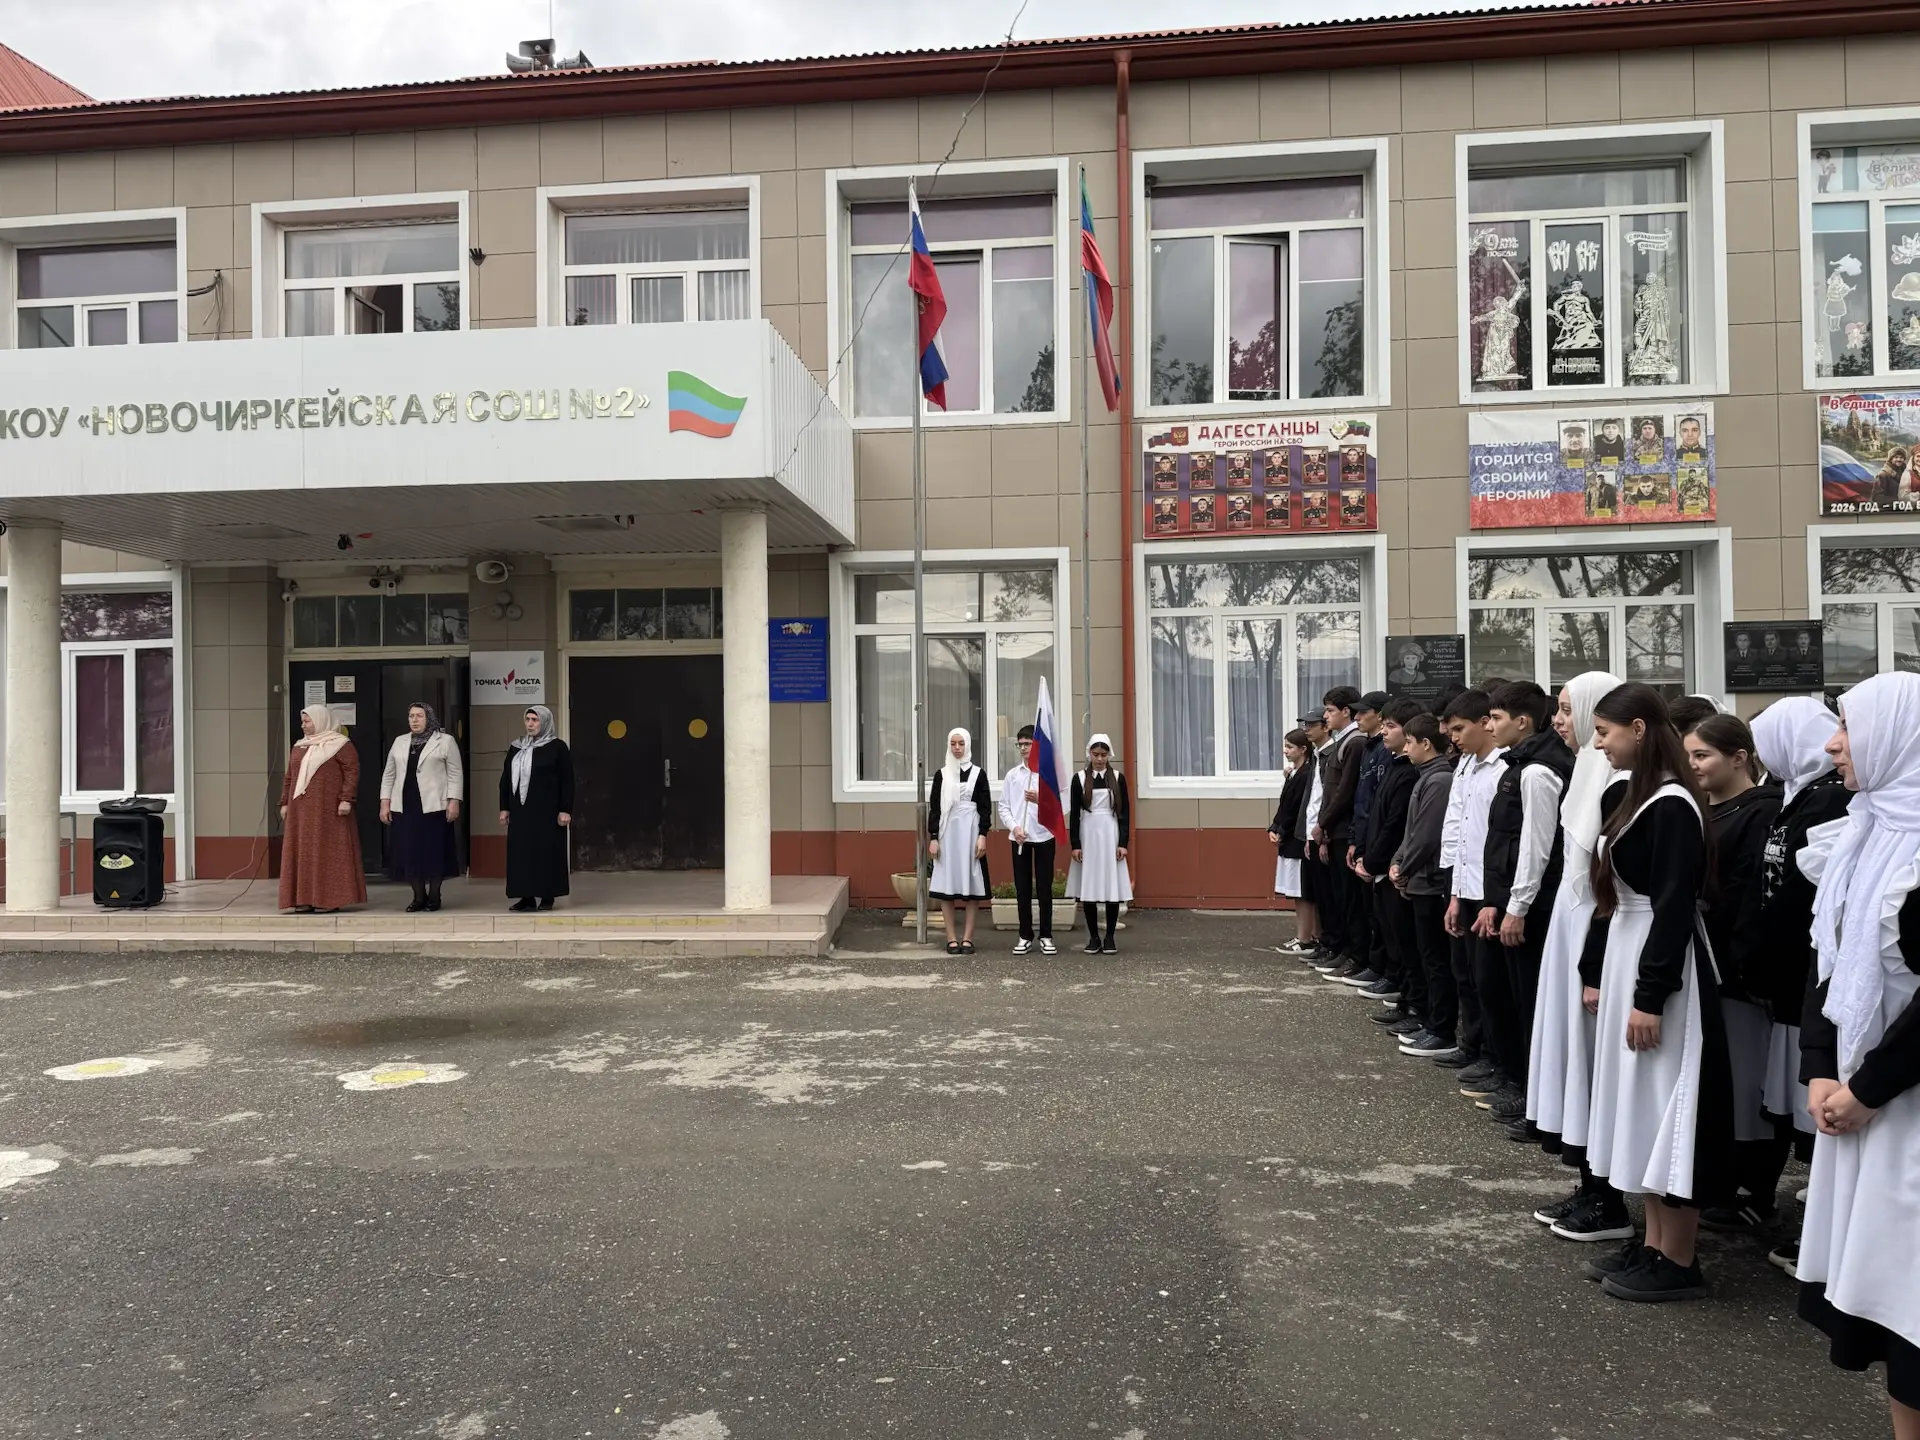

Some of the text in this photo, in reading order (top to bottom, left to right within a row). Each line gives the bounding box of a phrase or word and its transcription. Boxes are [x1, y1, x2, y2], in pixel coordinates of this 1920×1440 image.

[1830, 399, 1839, 410] В
[1842, 399, 1903, 411] единстве
[77, 388, 457, 437] «НОВОЧИРКЕЙСКАЯ
[464, 388, 560, 422] СОШ
[1198, 420, 1319, 440] ДАГЕСТАНЦЫ
[1213, 437, 1303, 448] ГЕРОИ РОССИИ НА СВО
[1475, 452, 1553, 466] ГОРДИТСЯ
[1480, 471, 1548, 484] СВОИМИ
[1479, 489, 1551, 502] ГЕРОЯМИ
[1830, 503, 1855, 513] 2026
[1859, 501, 1880, 513] ГОД
[1892, 501, 1913, 511] ГОД
